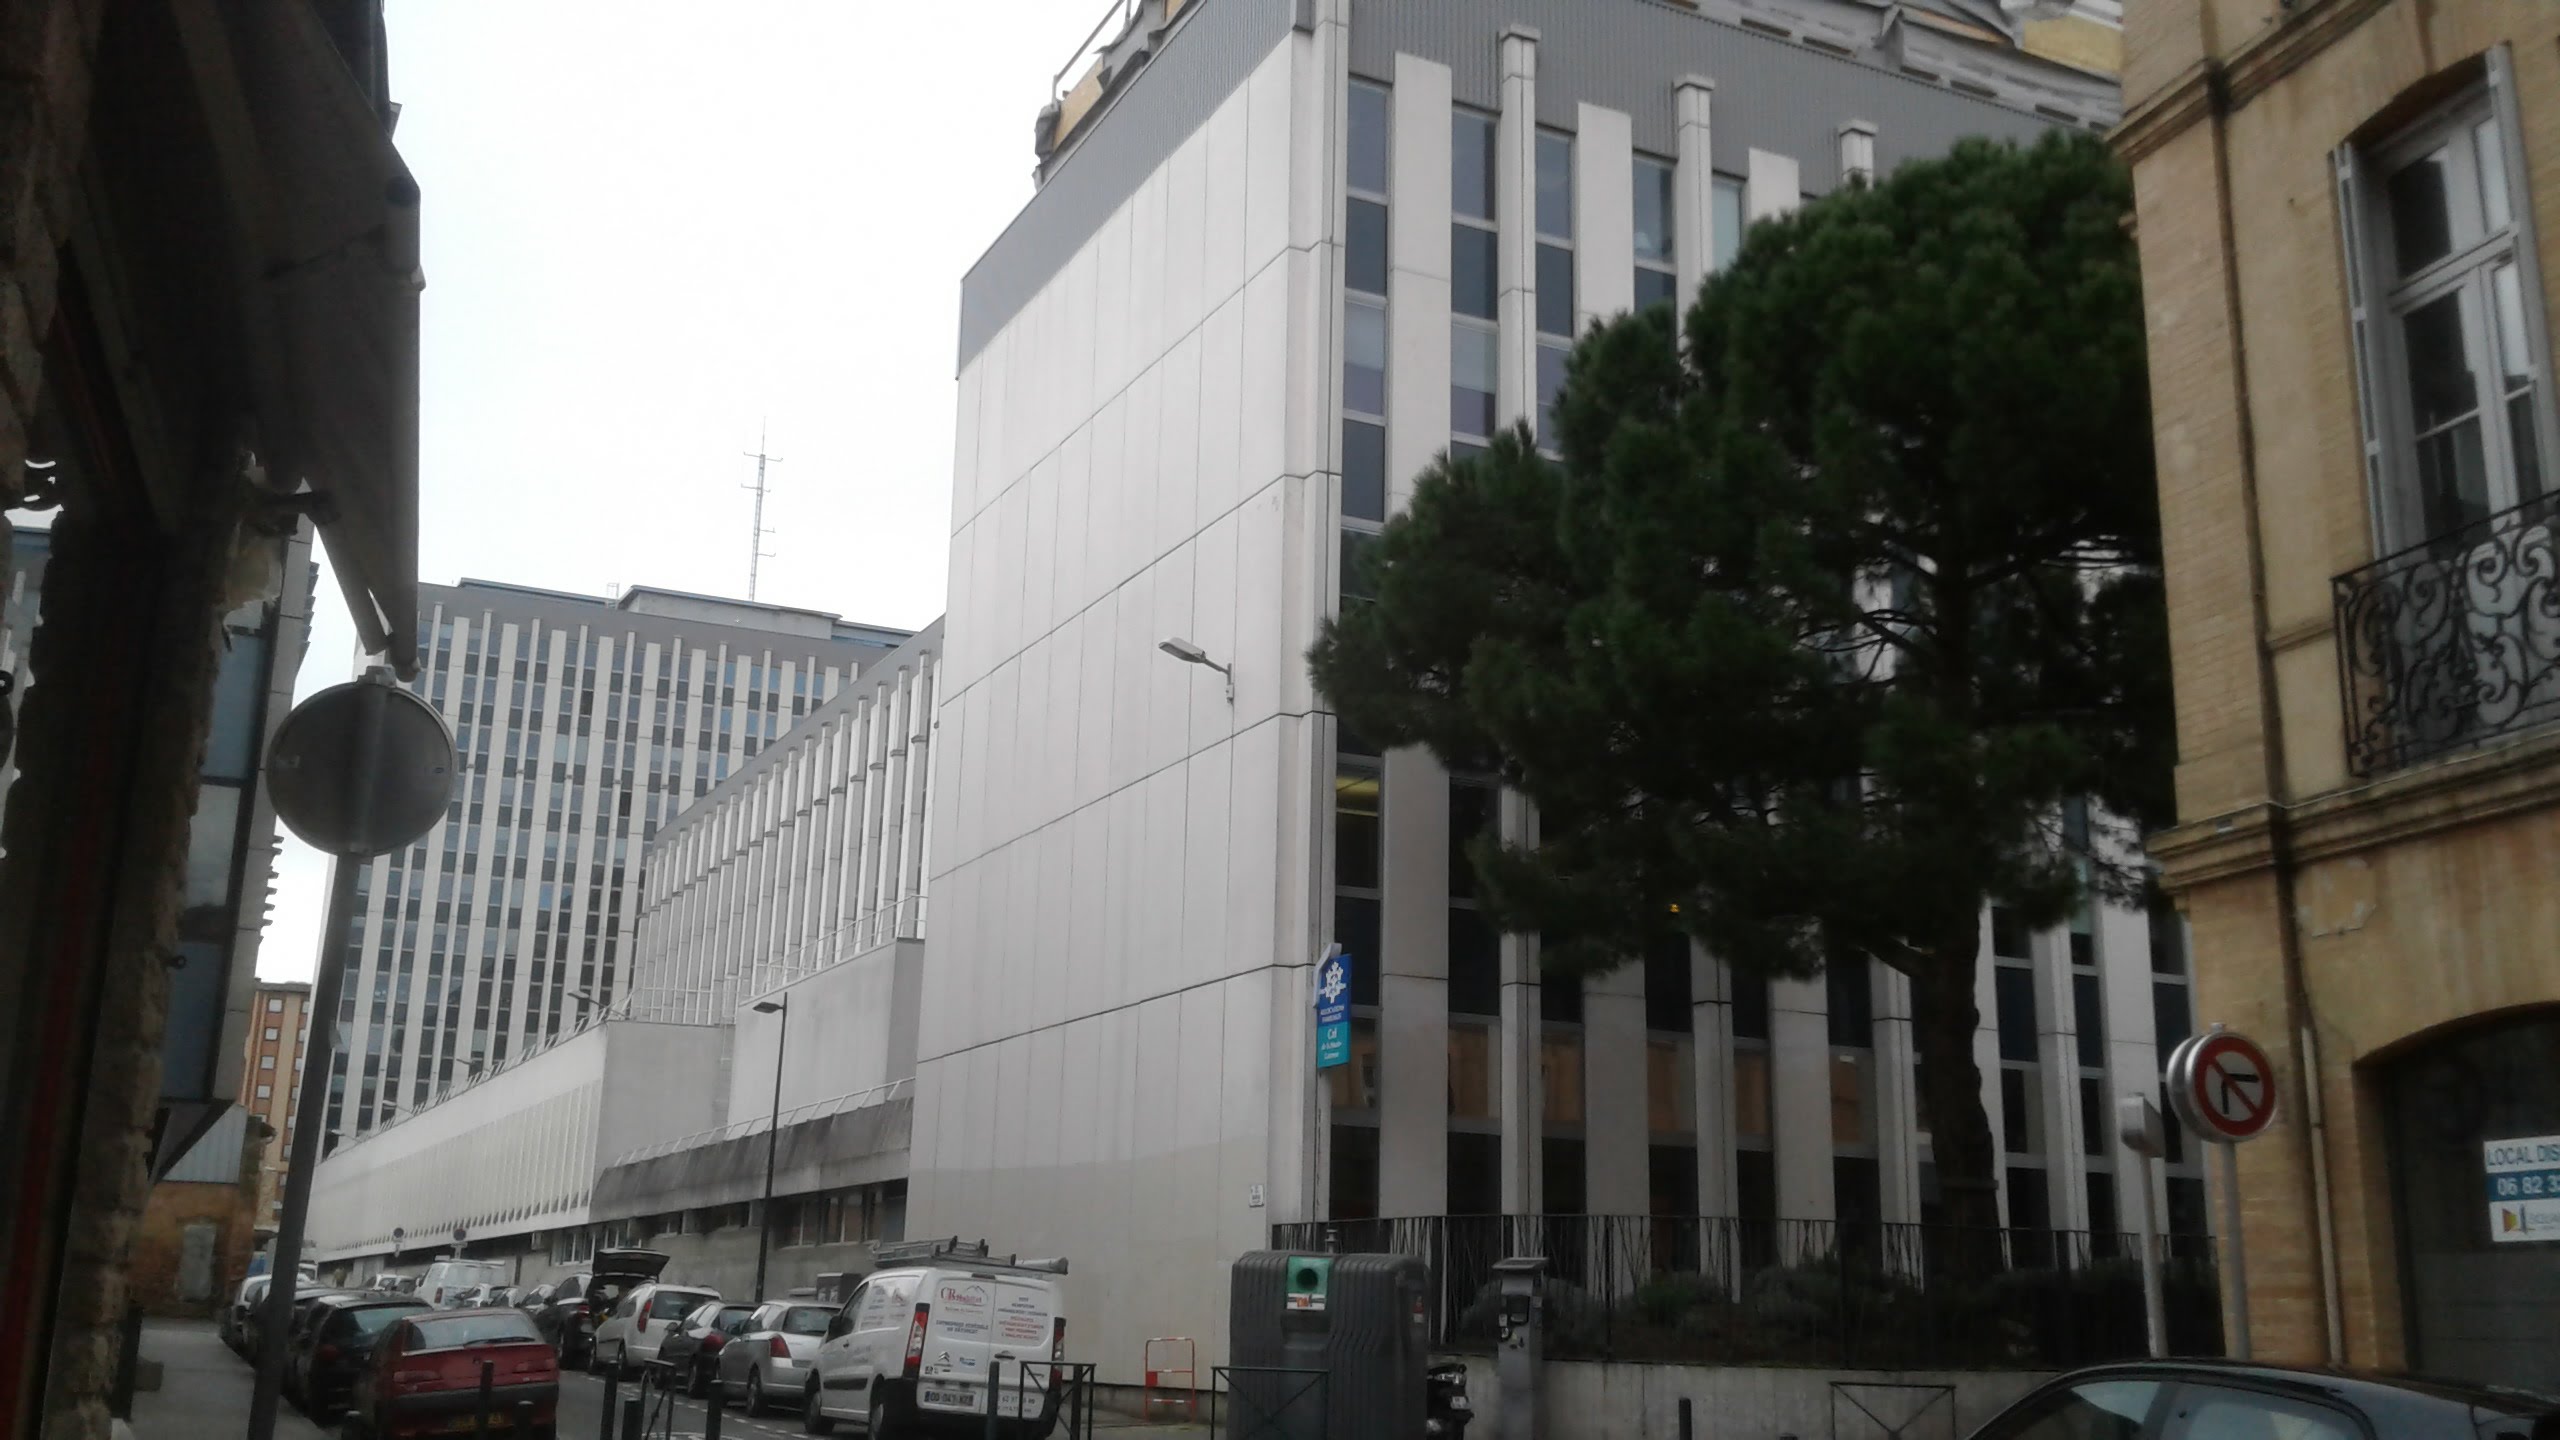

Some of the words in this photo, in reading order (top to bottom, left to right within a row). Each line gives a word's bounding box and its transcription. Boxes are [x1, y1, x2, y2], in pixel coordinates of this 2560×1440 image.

[2487, 1146, 2533, 1166] LOCAL
[2497, 1178, 2518, 1196] 06
[2522, 1176, 2542, 1194] 82
